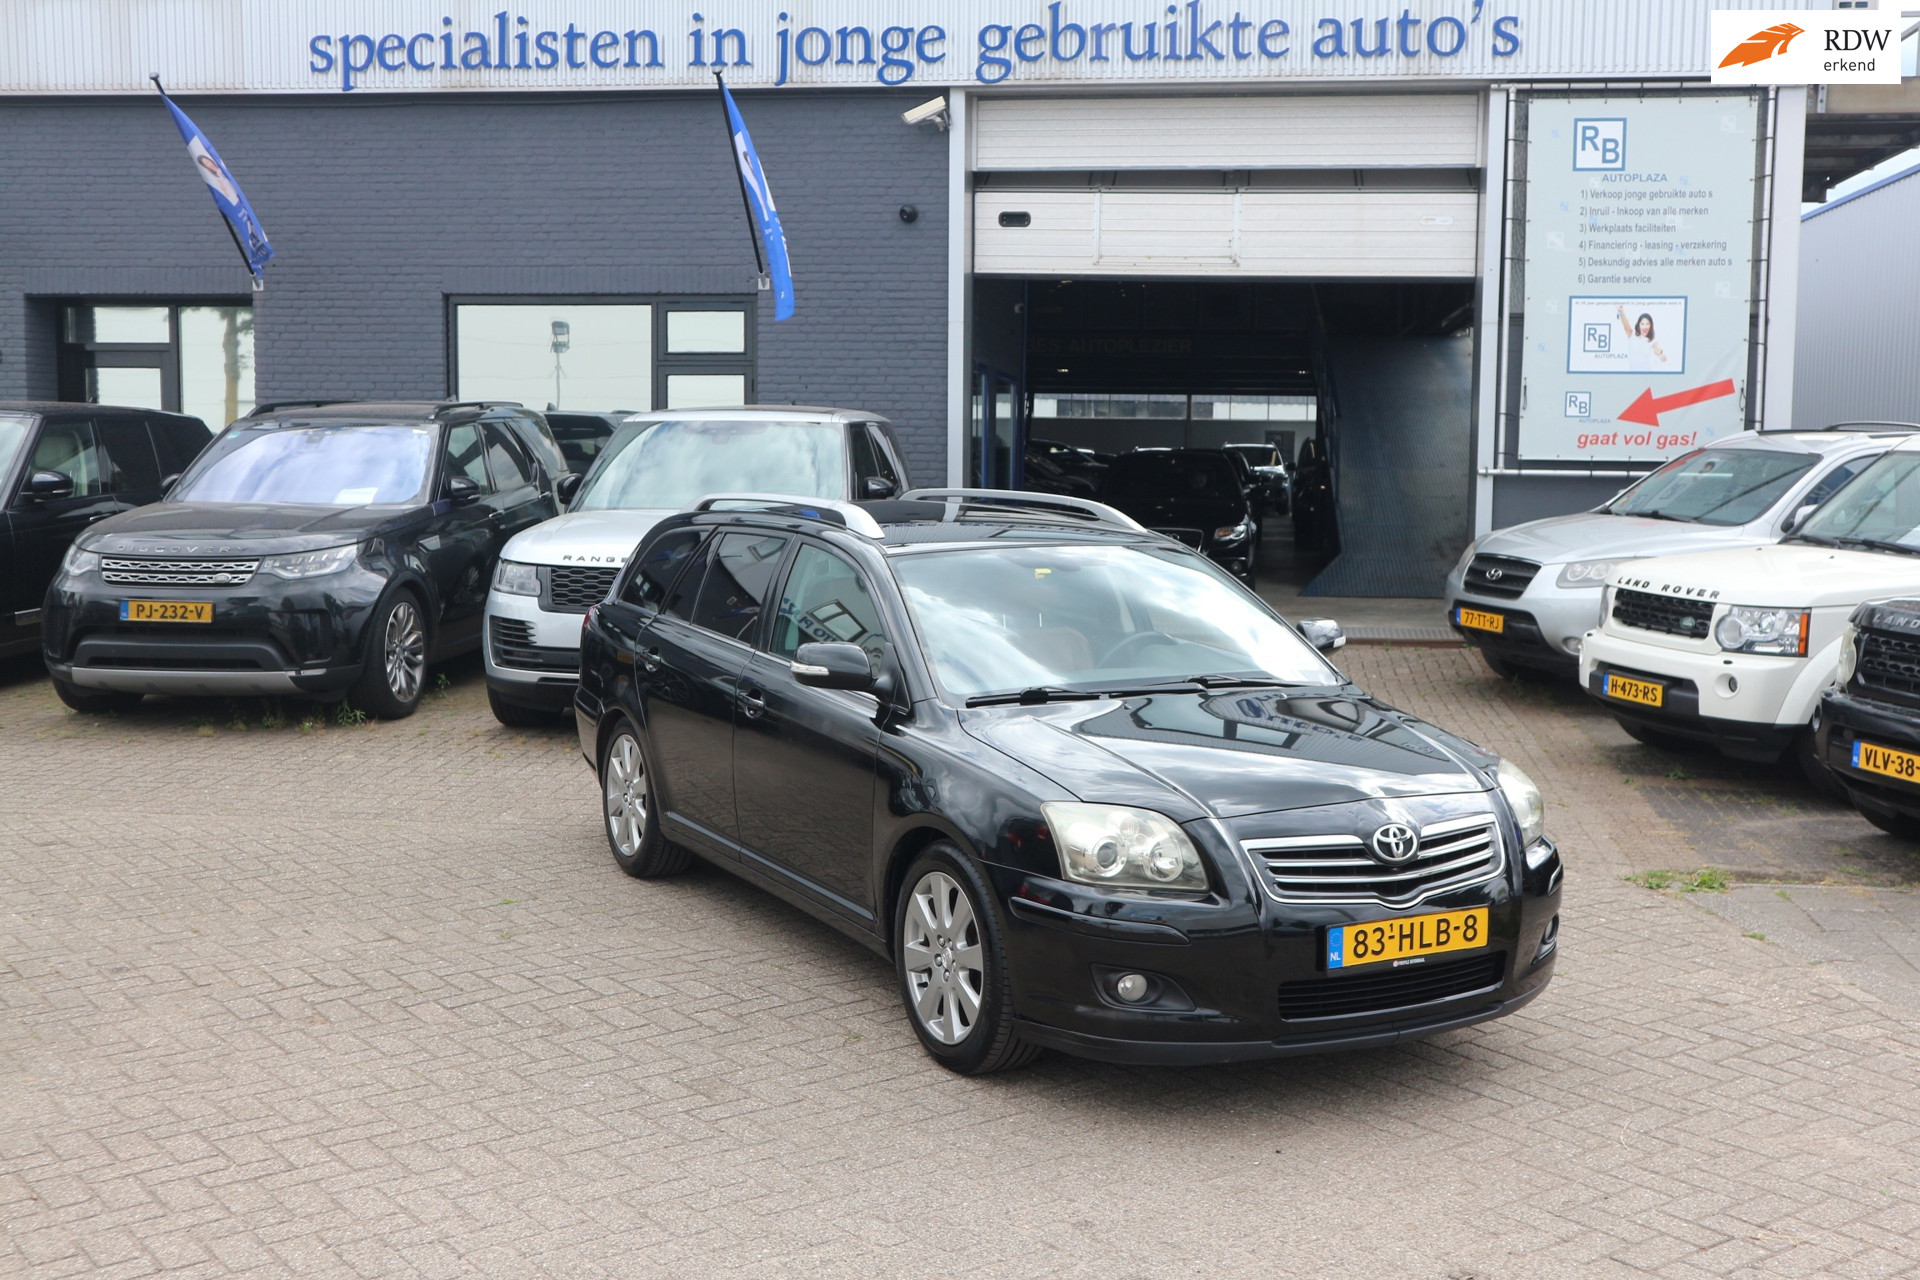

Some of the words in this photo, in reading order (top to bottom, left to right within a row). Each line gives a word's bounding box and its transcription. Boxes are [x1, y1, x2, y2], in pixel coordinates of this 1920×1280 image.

[309, 11, 663, 91] specialisten
[688, 12, 752, 67] in
[774, 11, 946, 86] jonge
[975, 0, 1290, 84] gebruikte
[1312, 0, 1520, 58] auto's
[1602, 173, 1668, 182] AUTOPLAZA
[1581, 190, 1588, 199] 1)
[1590, 190, 1623, 200] Verkoop
[1624, 190, 1647, 200] jonge
[1649, 190, 1687, 200] gebruikte
[1580, 206, 1588, 216] 2)
[1589, 206, 1610, 215] Inruil
[1616, 206, 1645, 217] Inkoop
[1662, 206, 1677, 215] alle
[1678, 206, 1709, 215] merken
[1579, 223, 1587, 233] 3)
[1589, 223, 1633, 234] Werkplaats
[1635, 223, 1676, 232] faciliteiten
[1578, 240, 1586, 250] 4)
[1588, 240, 1638, 251] Financiering
[1645, 240, 1673, 251] leasing
[1681, 240, 1727, 251] verzekering
[1578, 258, 1586, 268] 5)
[1588, 257, 1630, 268] Deskundig
[1632, 257, 1658, 267] advies
[1660, 257, 1674, 267] alle
[1676, 257, 1706, 266] merken
[1578, 274, 1586, 285] 6)
[1587, 274, 1622, 284] Garantie
[1623, 274, 1652, 283] service
[1577, 431, 1618, 449] gaat
[1623, 431, 1652, 446] vol
[1656, 431, 1697, 449] gas!
[116, 544, 248, 553] DISCOVERY
[563, 555, 629, 563] RANGE
[1617, 577, 1650, 588] LAND
[1661, 584, 1721, 599] ROVER
[136, 604, 205, 619] PJ-232-V
[1464, 611, 1500, 630] 77-TT-RJ
[1872, 613, 1920, 629] LAND
[1611, 678, 1658, 703] H-473-RS
[1330, 952, 1341, 962] NL
